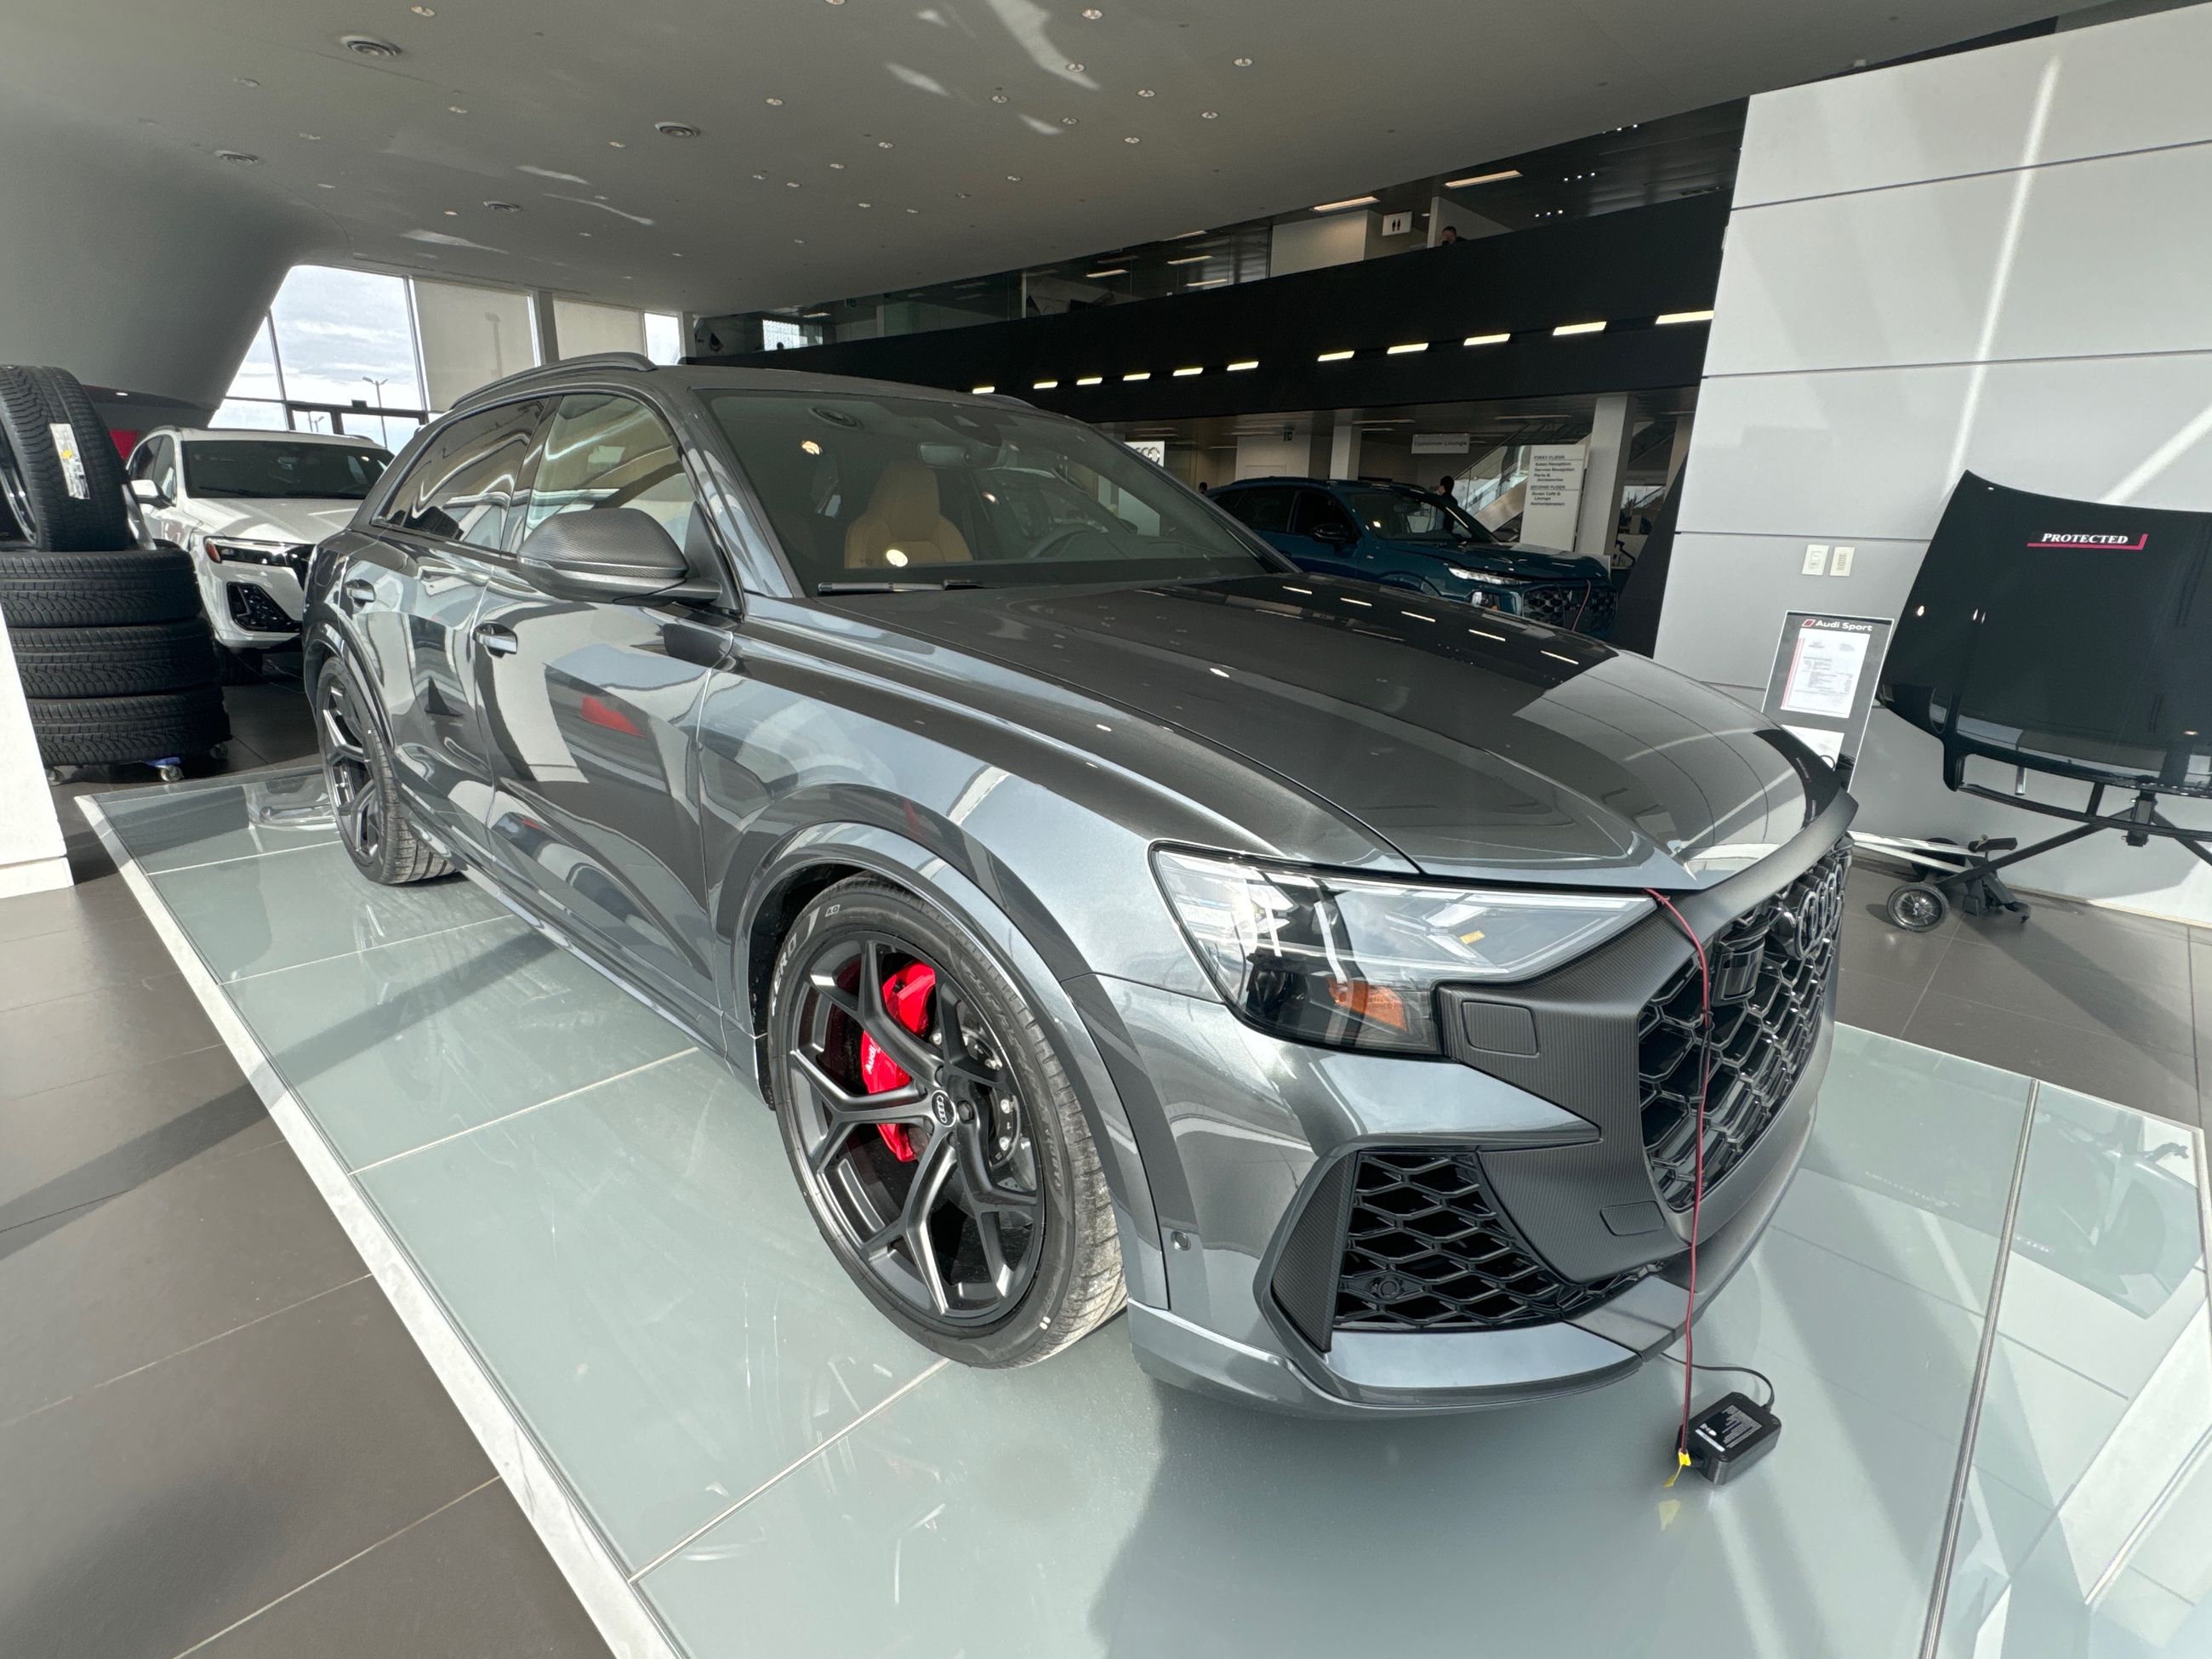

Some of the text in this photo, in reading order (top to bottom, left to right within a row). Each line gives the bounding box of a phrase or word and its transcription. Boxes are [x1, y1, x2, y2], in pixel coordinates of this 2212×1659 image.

[2041, 533, 2129, 544] PROTECTED
[1815, 619, 1874, 632] Audi Sport
[864, 1044, 877, 1075] Audi
